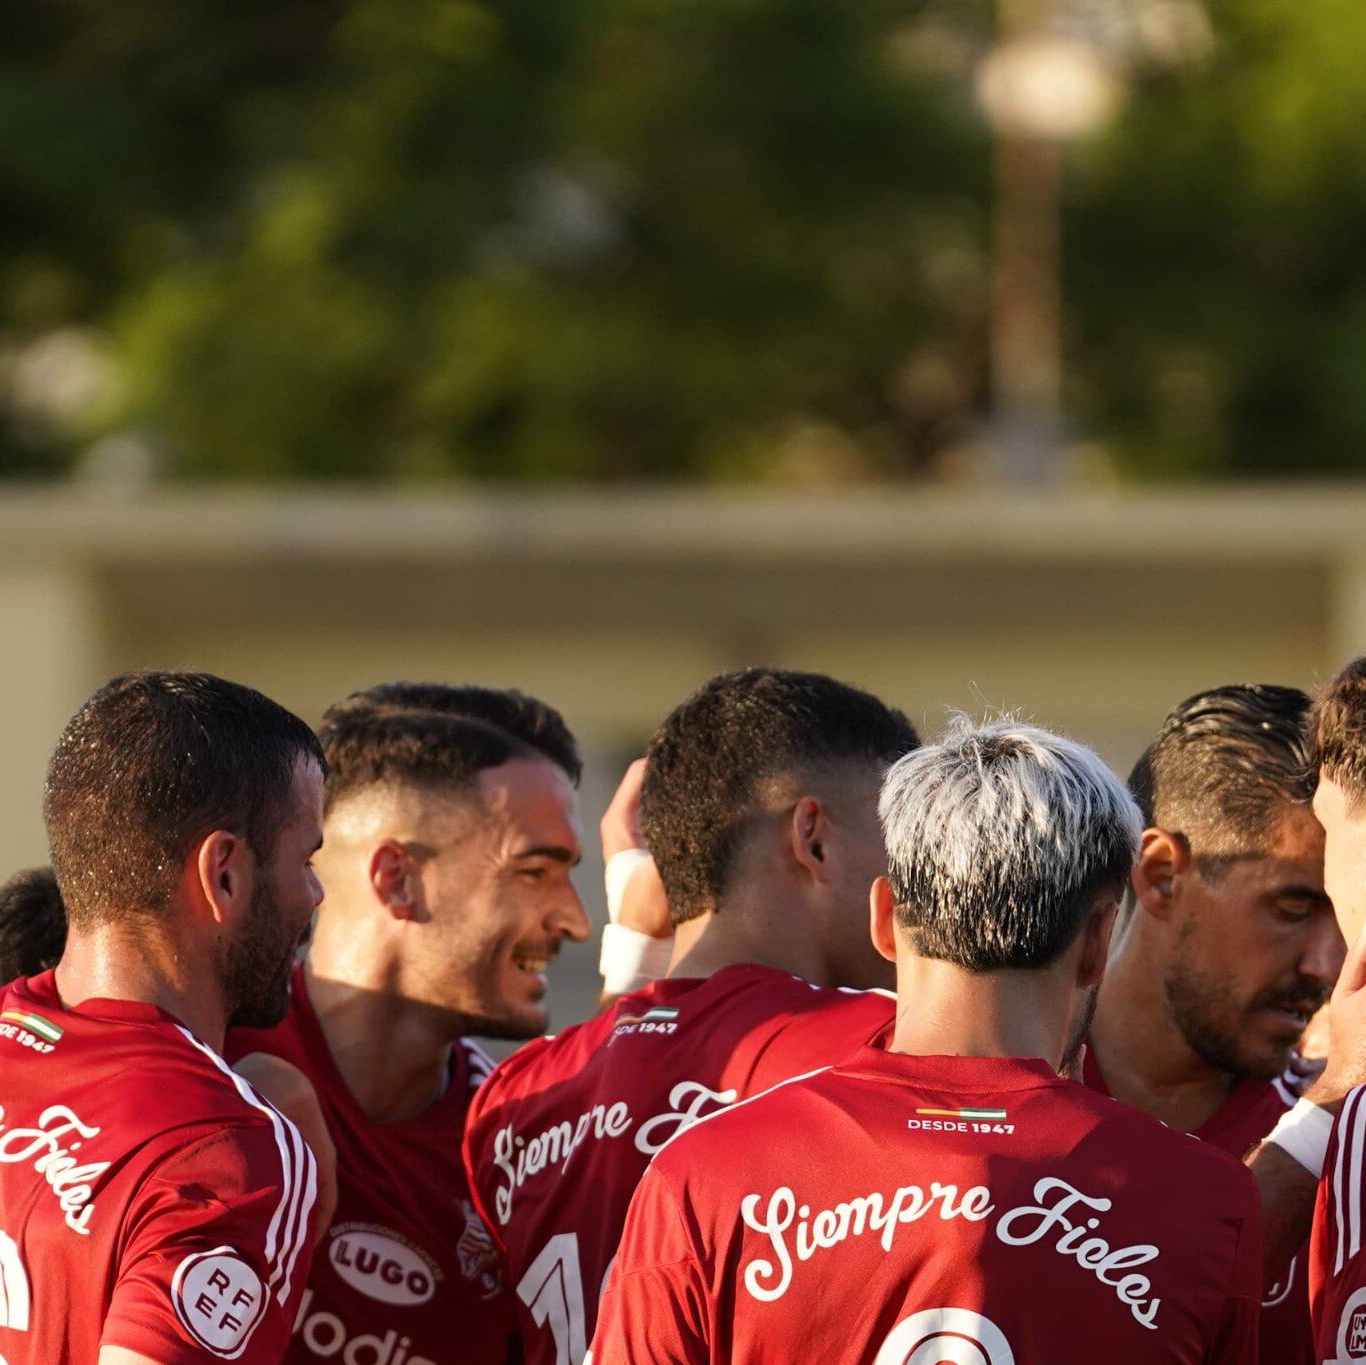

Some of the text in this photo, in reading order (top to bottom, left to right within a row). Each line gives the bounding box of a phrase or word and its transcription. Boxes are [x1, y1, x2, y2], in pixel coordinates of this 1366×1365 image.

[16, 1030, 55, 1053] 1947
[638, 1022, 678, 1034] 1947
[907, 1119, 1015, 1134] DESDE 1947
[494, 1102, 633, 1225] Siempre
[334, 1240, 430, 1295] LUGO
[740, 1177, 1162, 1329] Siempre Fieles
